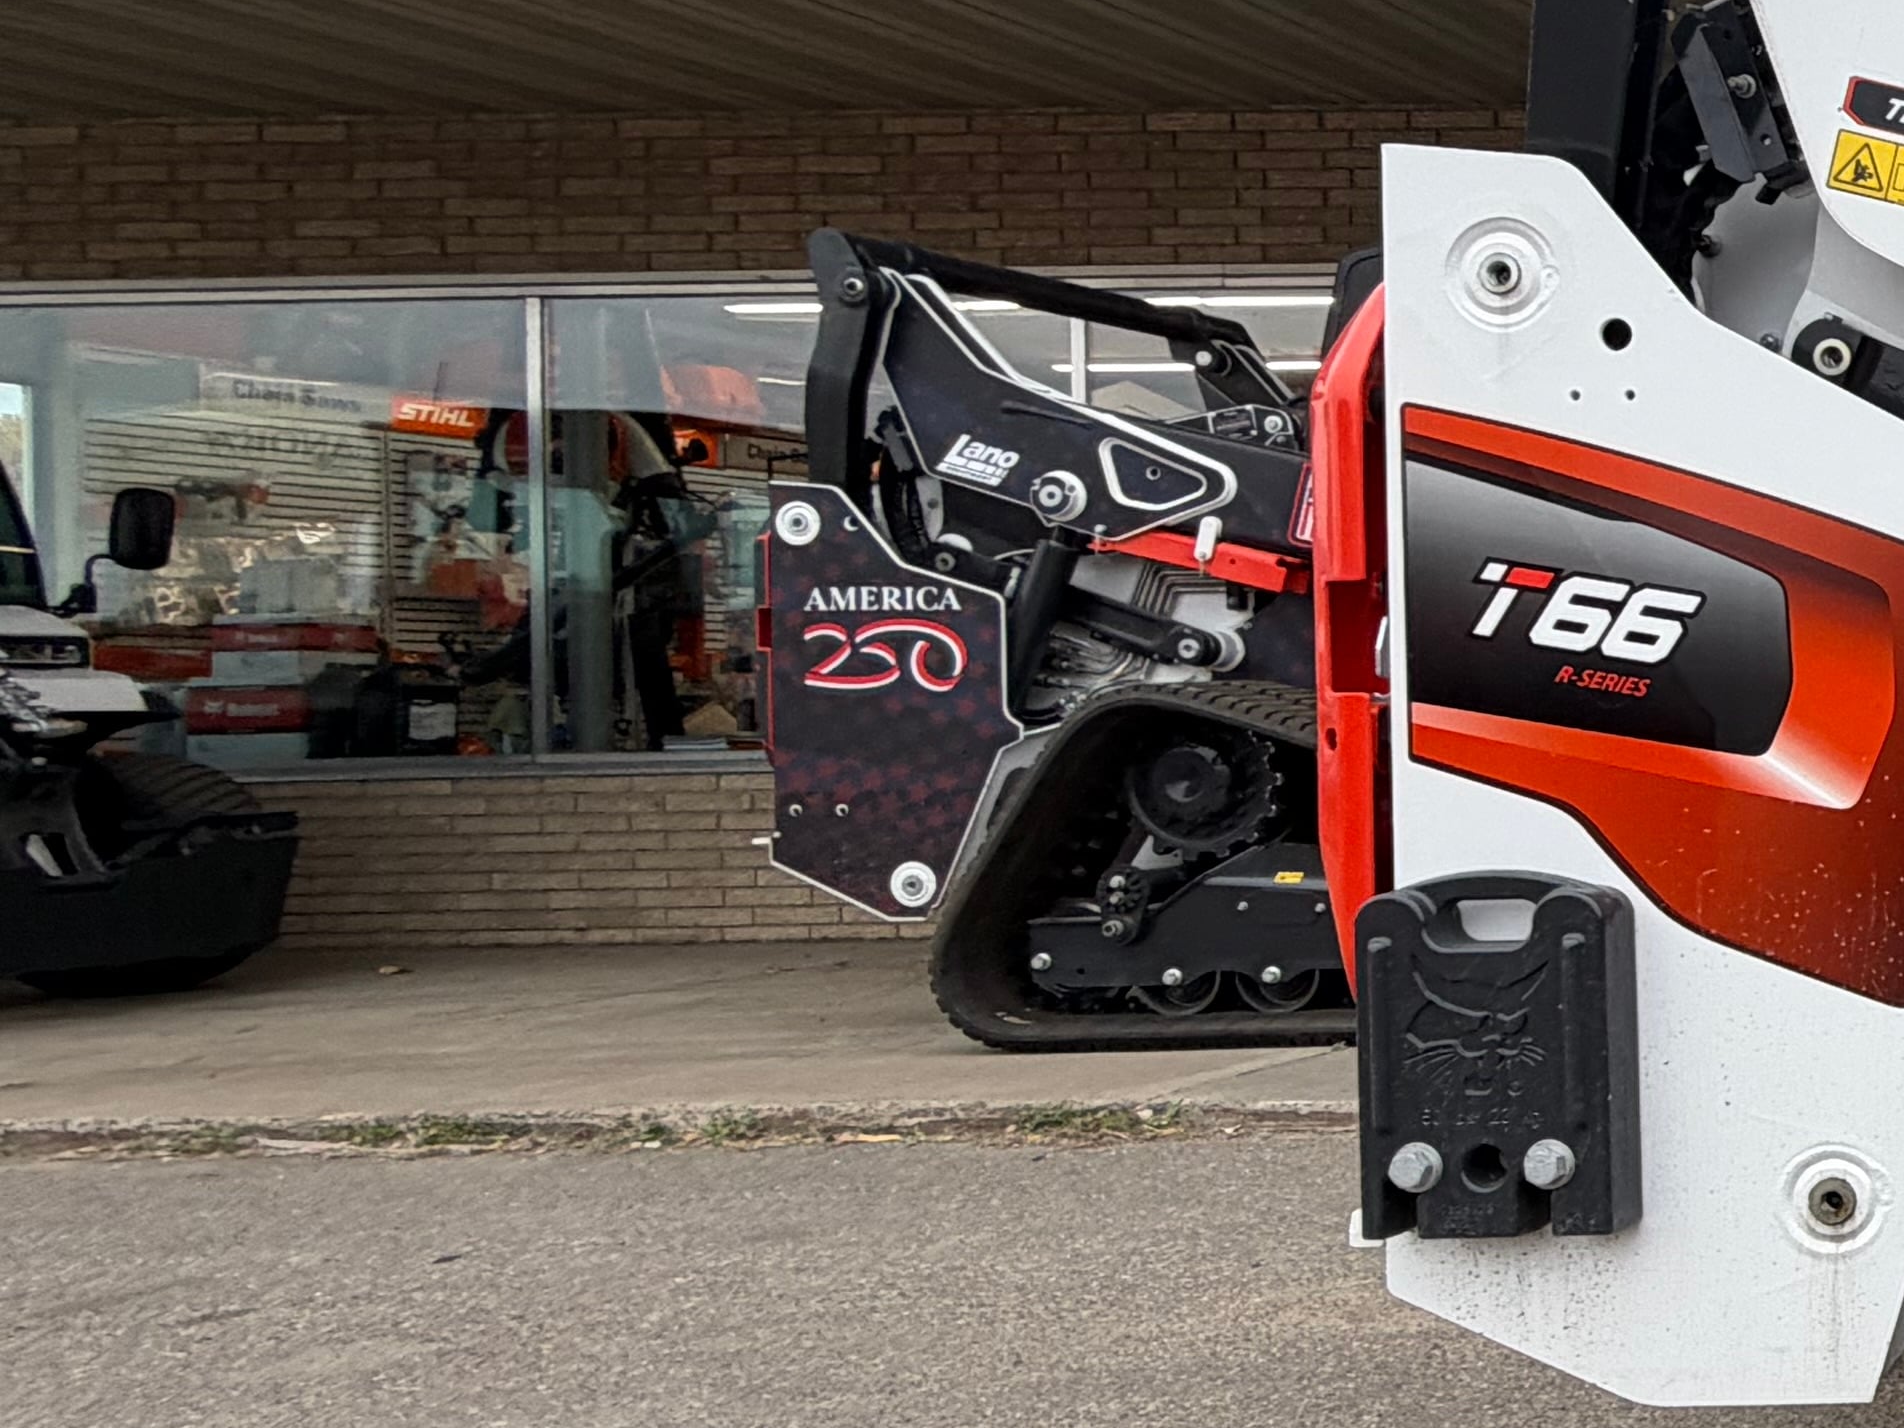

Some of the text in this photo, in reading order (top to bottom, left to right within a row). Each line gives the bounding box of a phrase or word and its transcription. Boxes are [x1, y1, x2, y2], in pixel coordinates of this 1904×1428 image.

[397, 403, 475, 428] STIHL
[943, 433, 1020, 469] Lano
[803, 586, 963, 612] AMERICA
[1471, 561, 1703, 664] T66
[1554, 665, 1652, 698] R-SERIES
